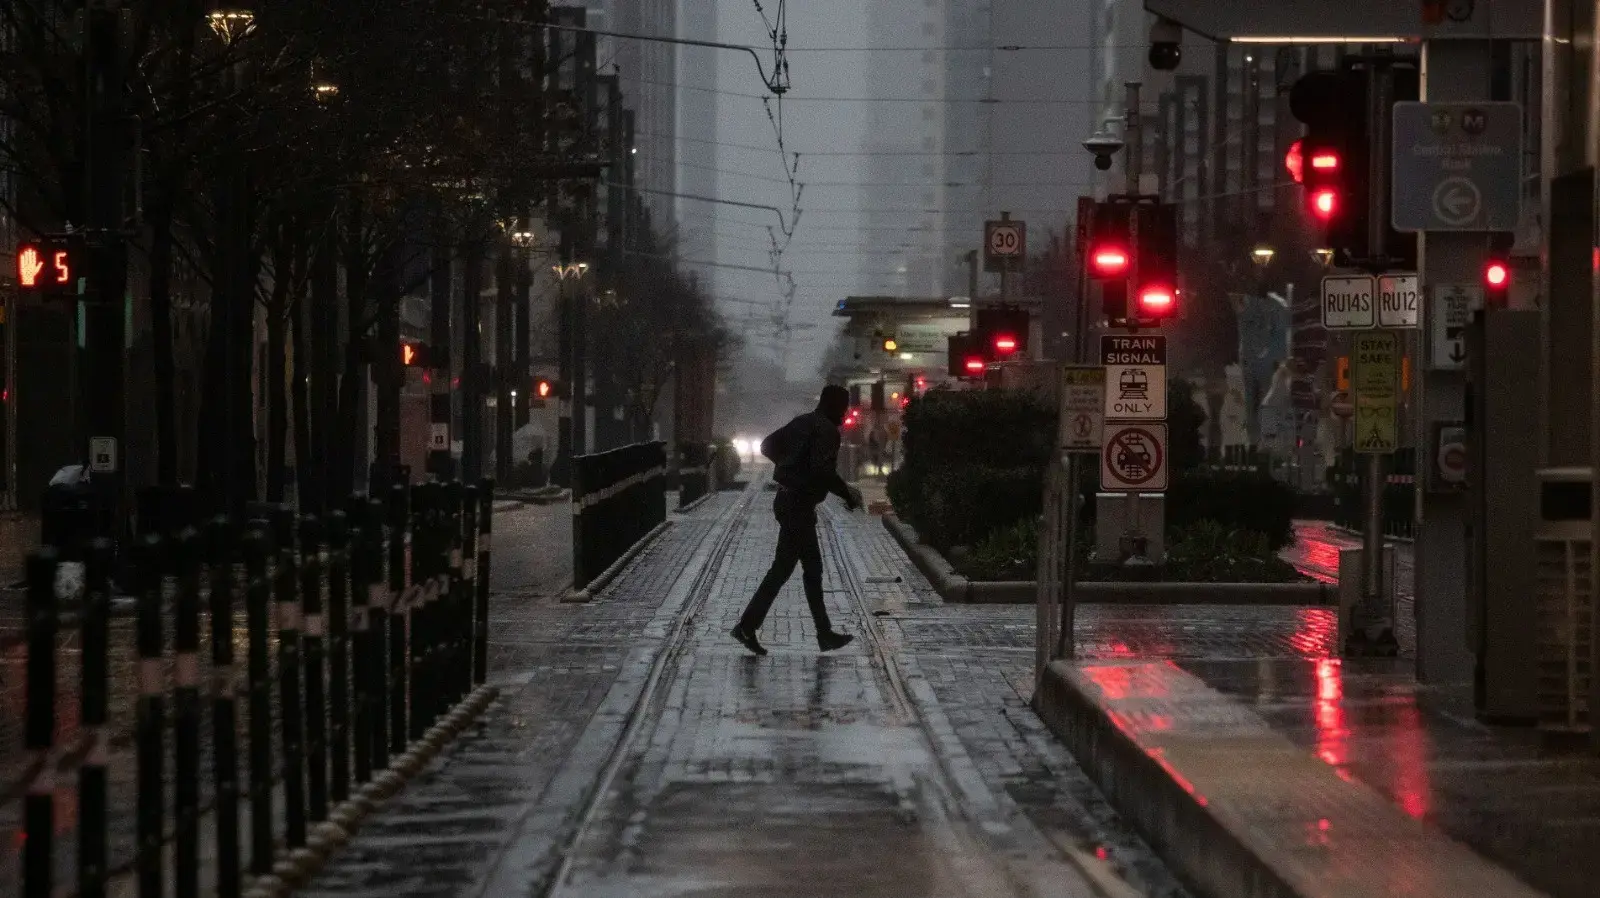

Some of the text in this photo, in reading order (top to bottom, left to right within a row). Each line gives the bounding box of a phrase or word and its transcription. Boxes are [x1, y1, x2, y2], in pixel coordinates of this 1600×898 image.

[1463, 115, 1485, 128] M
[995, 232, 1015, 247] 30
[55, 251, 69, 282] 5
[1328, 293, 1369, 312] RU14S
[1112, 338, 1156, 350] TRAIN
[1360, 340, 1391, 351] STAY
[1107, 352, 1160, 363] SIGNAL
[1360, 353, 1392, 364] SAFE
[1113, 403, 1153, 413] ONLY
